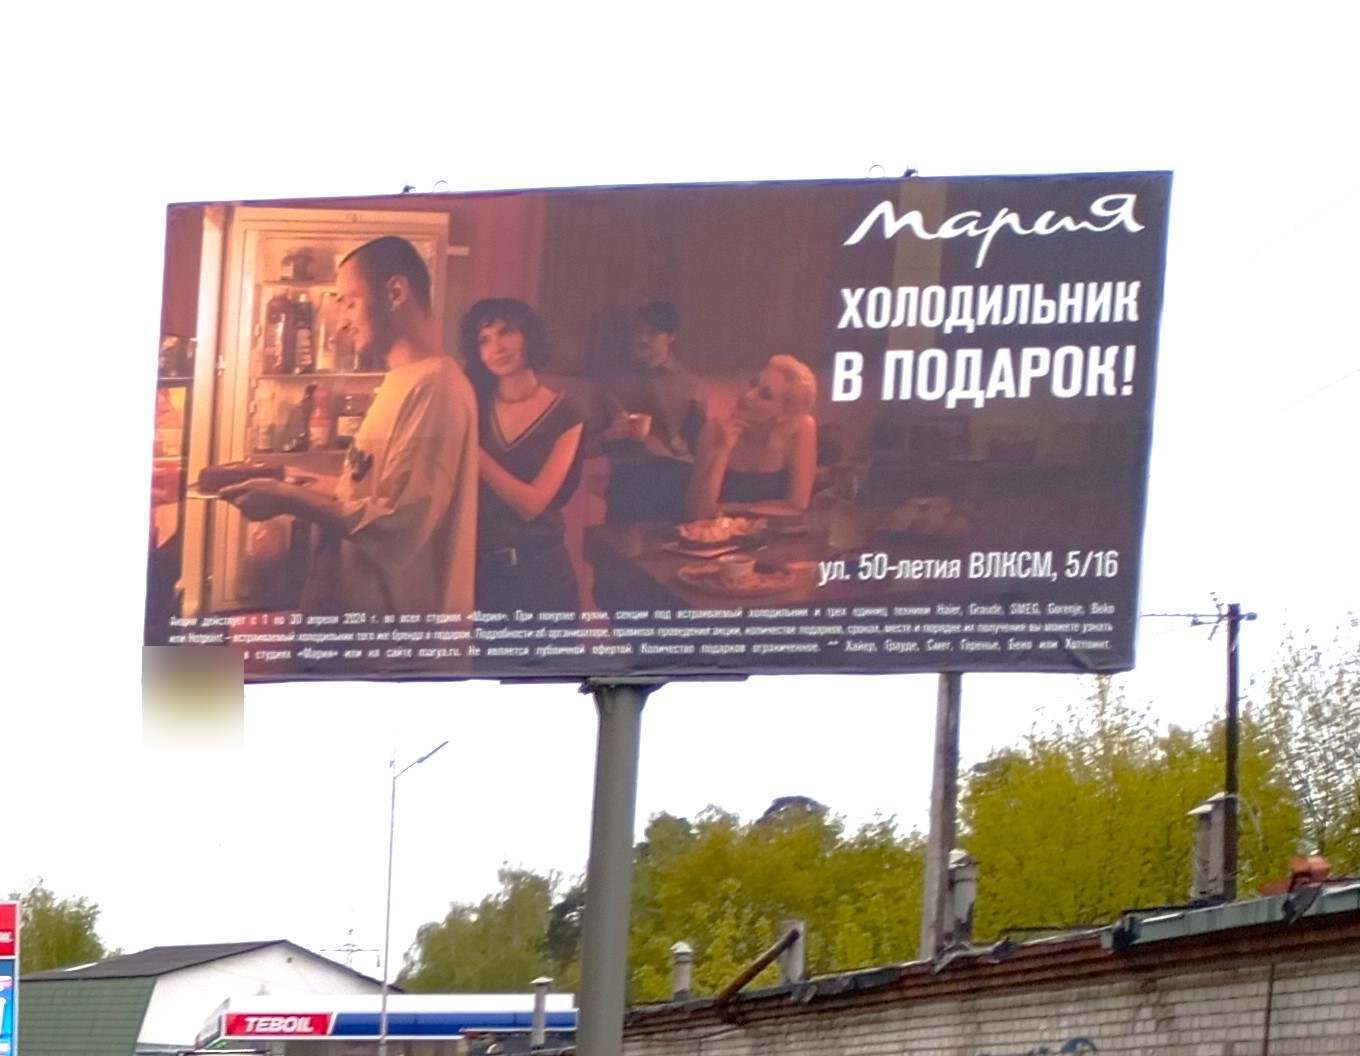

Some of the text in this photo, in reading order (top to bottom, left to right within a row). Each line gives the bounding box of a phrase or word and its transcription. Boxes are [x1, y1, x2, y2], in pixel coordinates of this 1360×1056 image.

[843, 193, 1145, 268] Мария
[837, 281, 1141, 334] ХОЛОДИЛЬНИК
[832, 345, 1137, 409] В ПОДАРОК!
[817, 550, 1119, 587] ул. 50-летия ВЛКСМ, 5/16
[244, 1016, 315, 1033] TEBOIL
